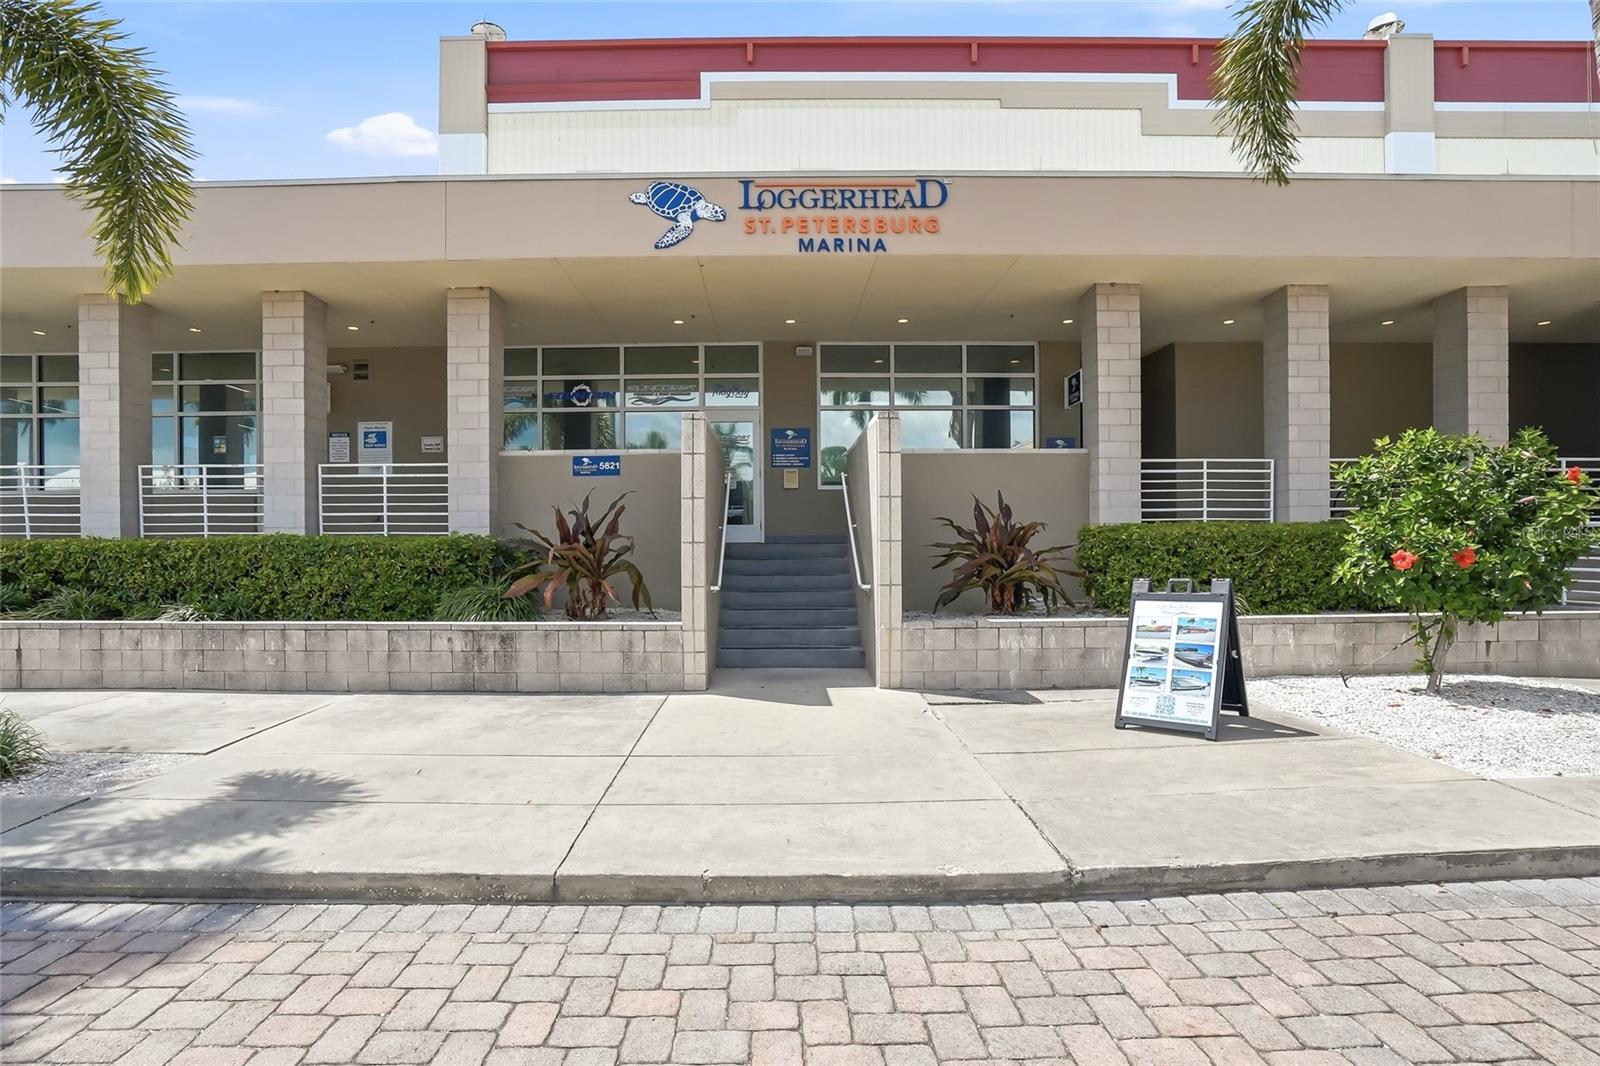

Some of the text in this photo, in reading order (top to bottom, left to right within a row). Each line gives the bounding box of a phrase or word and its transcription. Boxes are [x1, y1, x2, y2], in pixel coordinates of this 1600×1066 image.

[738, 179, 948, 211] LOGGERHEAD
[744, 217, 941, 235] ST. PETERSBURG
[798, 237, 887, 253] MARINA
[599, 461, 620, 470] 5821
